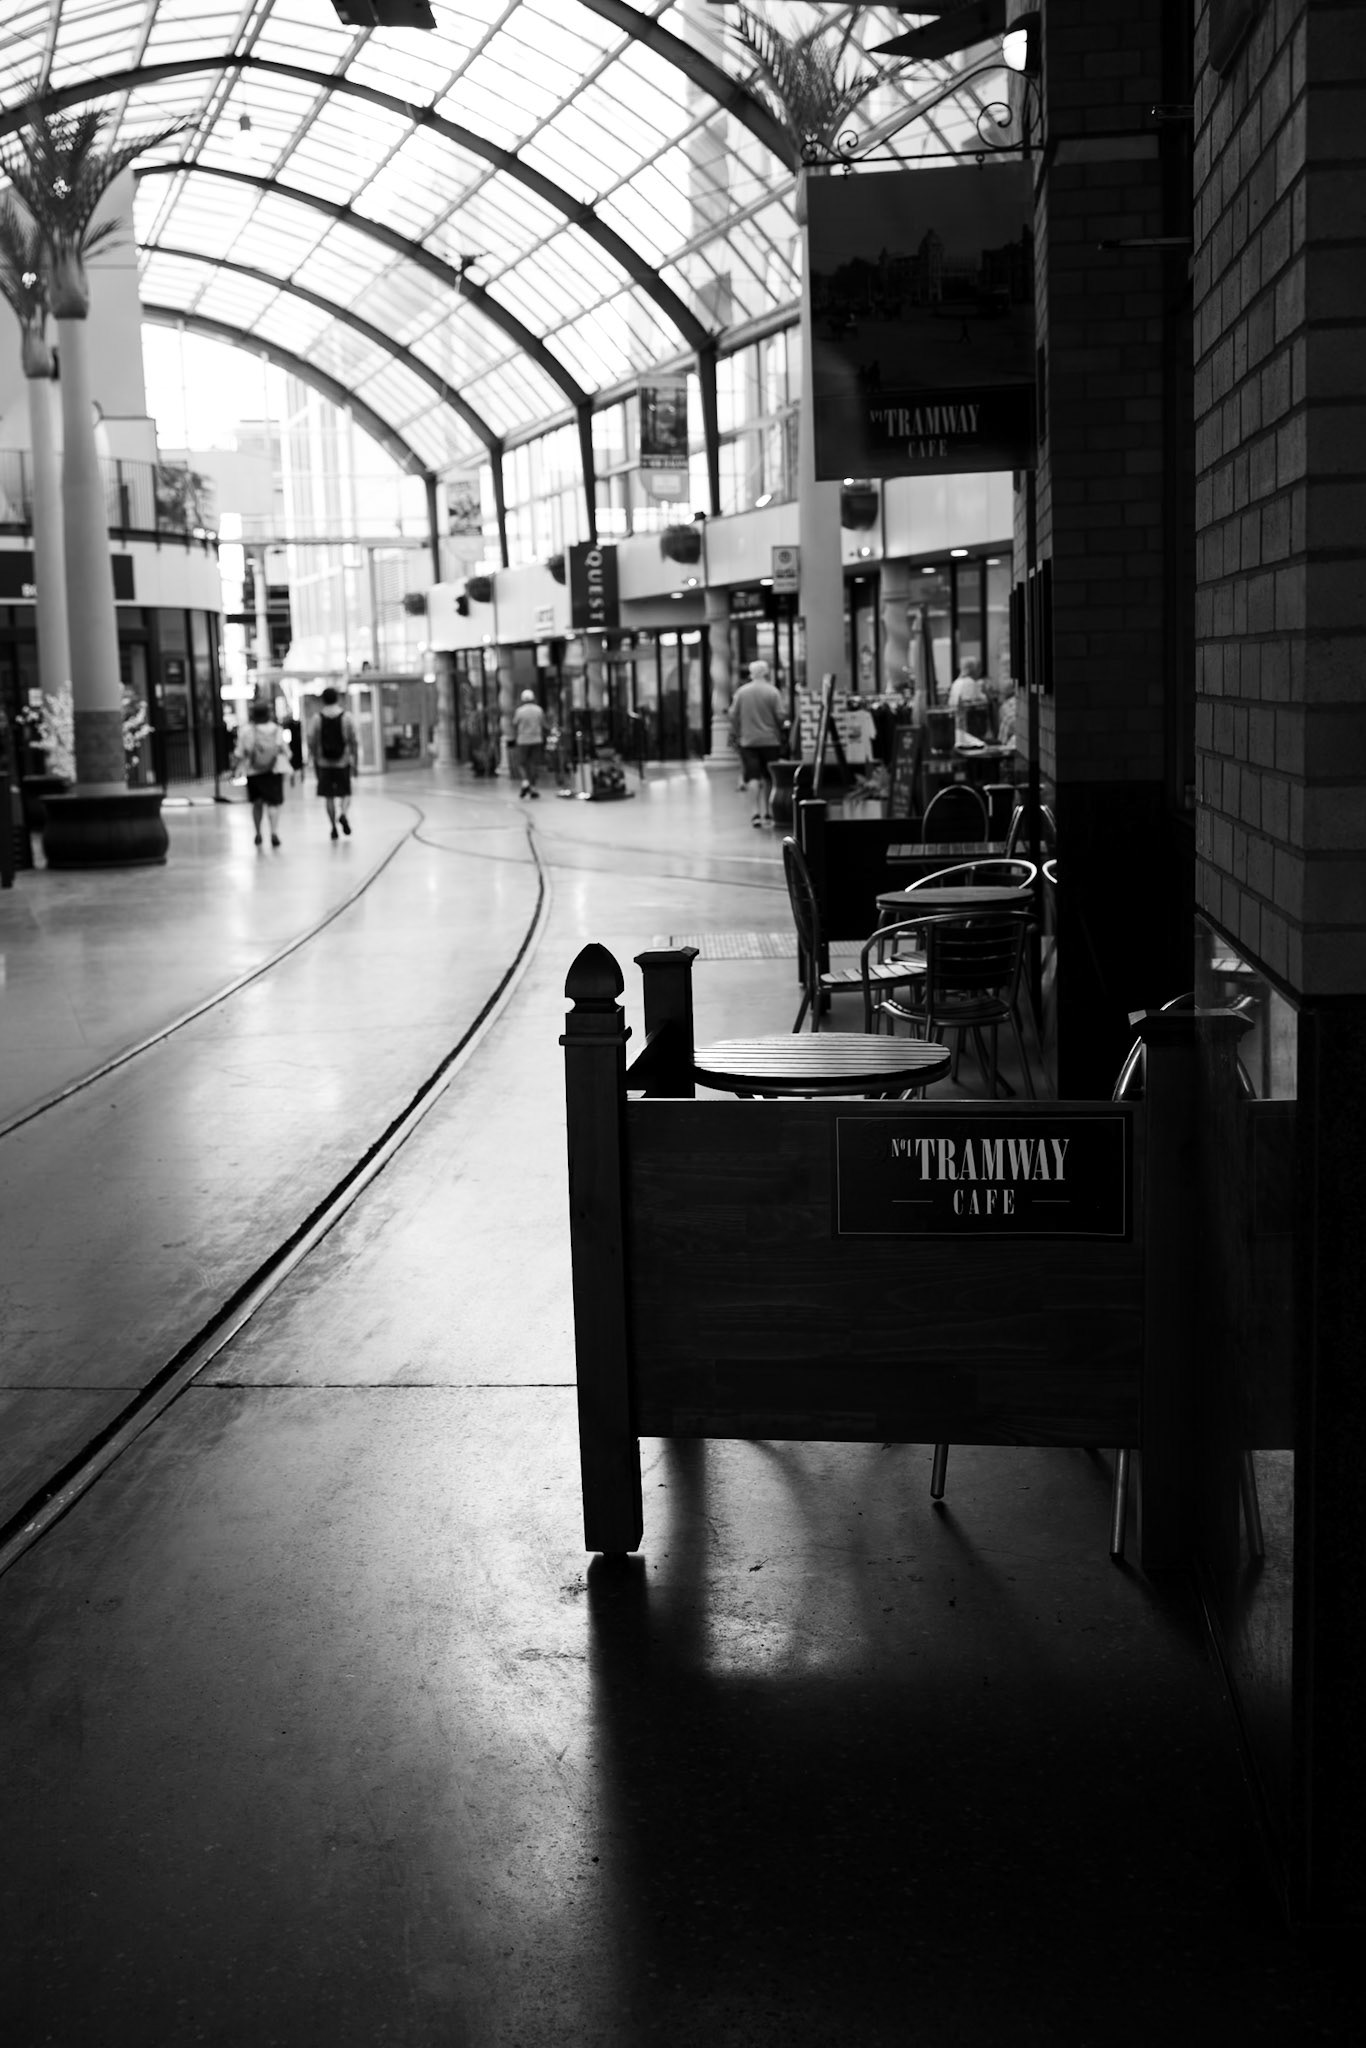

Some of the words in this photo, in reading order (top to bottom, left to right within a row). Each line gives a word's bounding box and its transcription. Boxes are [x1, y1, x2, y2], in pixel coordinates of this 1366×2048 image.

[884, 404, 980, 437] TRAMWAY
[908, 439, 948, 458] CAFE
[584, 551, 605, 620] QUEST
[914, 1138, 1070, 1181] TRAMWAY
[952, 1188, 1015, 1215] CAFE
